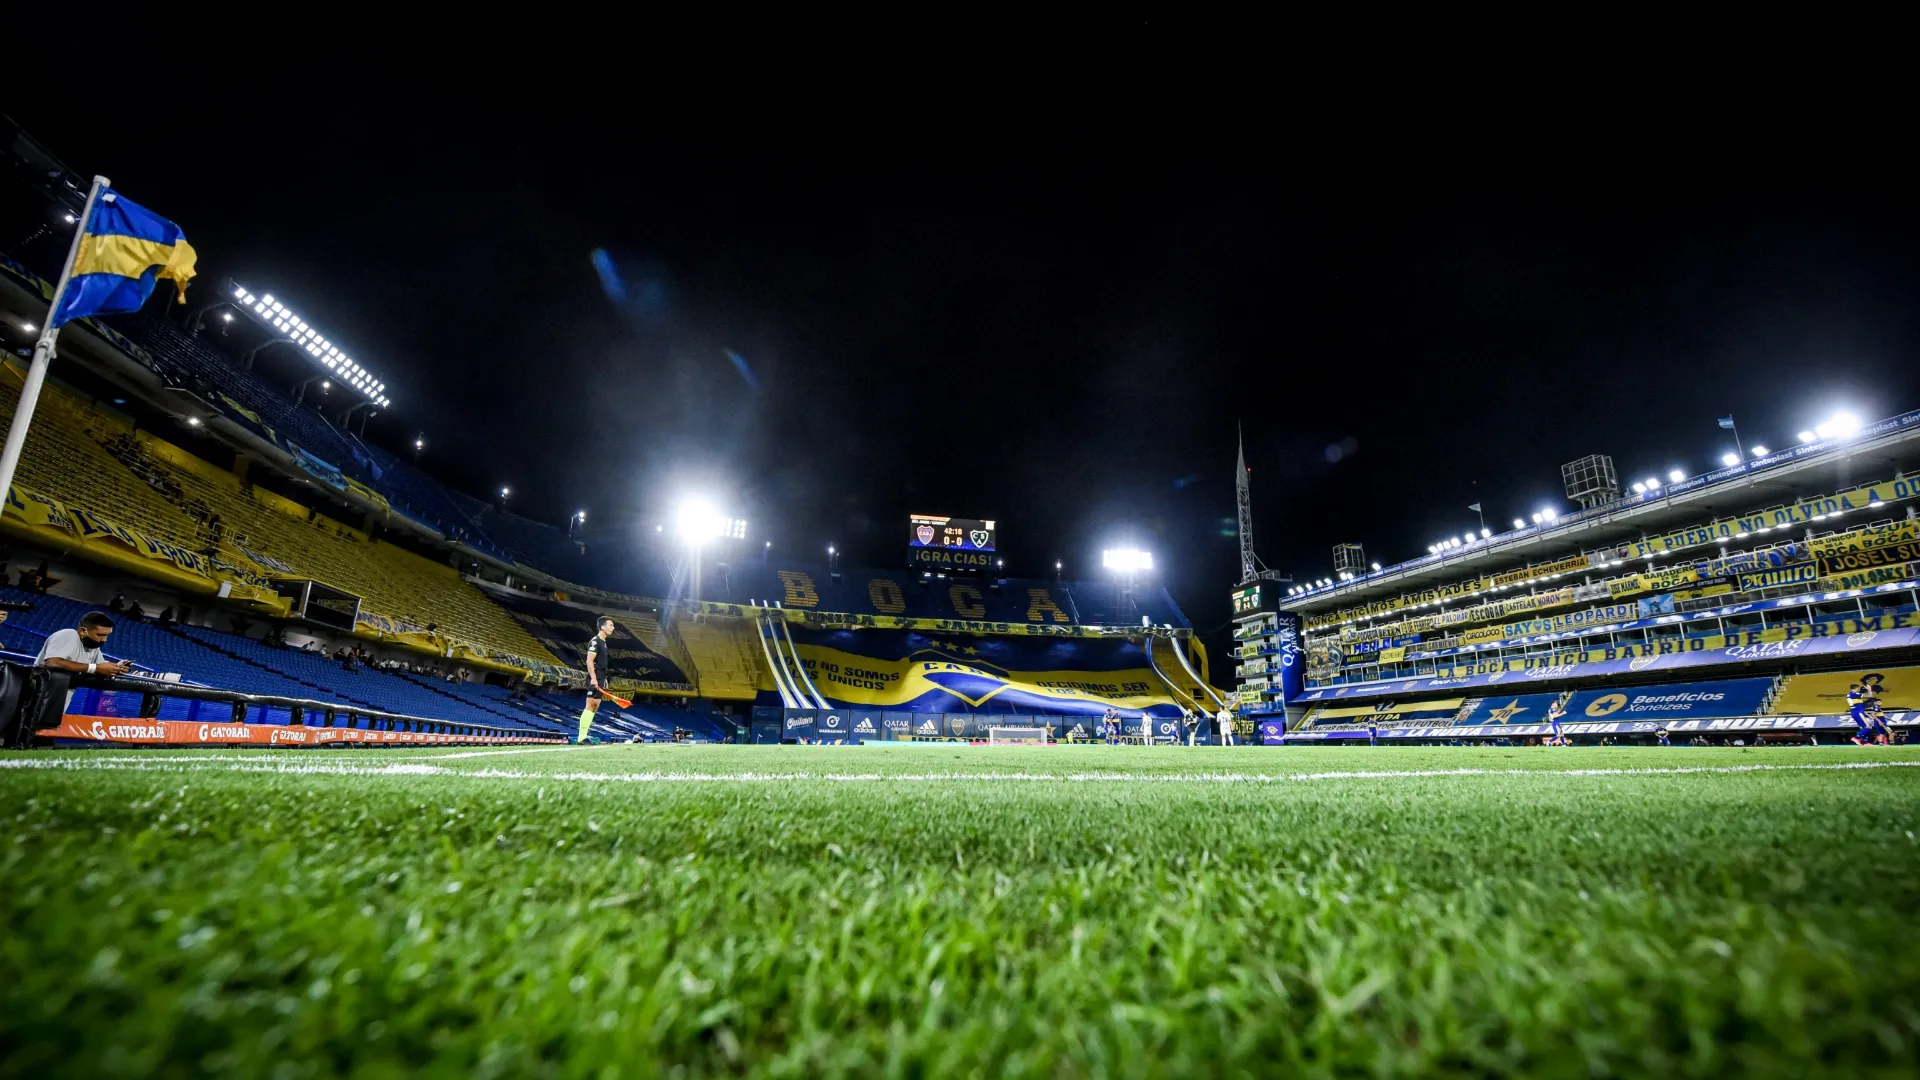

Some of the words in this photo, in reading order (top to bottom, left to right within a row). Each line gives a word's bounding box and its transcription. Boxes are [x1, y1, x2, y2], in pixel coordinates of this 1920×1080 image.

[1668, 477, 1705, 493] Sinteplast
[1706, 465, 1746, 482] Sinteplast
[1750, 451, 1793, 469] Sinteplast
[1635, 542, 1657, 557] EL
[1664, 523, 1731, 549] PUEBLO
[1738, 516, 1765, 534] NO
[1773, 496, 1855, 525] OLVIDA
[1868, 488, 1881, 504] A
[1825, 532, 1857, 543] UNICOS
[1862, 531, 1914, 548] BOCA
[1814, 543, 1860, 559] BOCA
[1494, 571, 1530, 586] ESTEBAN
[1533, 558, 1586, 577] ECHEVERRIA
[1643, 564, 1695, 580] BARADERO
[1651, 576, 1690, 590] BOCA
[1307, 611, 1341, 627] NUNCA
[1347, 600, 1396, 620] HICIMOS
[1403, 579, 1482, 606] AMISTADES
[1505, 599, 1536, 612] CASTELAR
[1441, 611, 1469, 623] PALOMAR
[1469, 604, 1505, 622] ESCOBAR
[1555, 604, 1635, 626] LEOPARDI
[935, 619, 1009, 633] JAMAS
[1279, 617, 1296, 667] QATAR
[1289, 617, 1300, 654] AIRWAYS
[1465, 661, 1511, 676] BOCA
[1523, 651, 1590, 670] UNICO
[1604, 637, 1705, 661] BARRIO
[1724, 630, 1763, 648] DE
[1725, 639, 1803, 657] QATAR
[1737, 648, 1796, 660] AIRWAYS
[827, 672, 885, 691] UNICOS
[844, 666, 901, 682] SOMOS
[1036, 681, 1119, 693] DECIDIMOS
[1120, 681, 1151, 692] SER
[1632, 691, 1726, 704] Beneficios
[1623, 702, 1693, 713] Xeneizes
[1511, 724, 1537, 735] LA
[1664, 720, 1701, 731] LA
[1706, 716, 1818, 731] NUEVA
[1404, 728, 1427, 737] LA
[1426, 727, 1482, 737] NUEVA
